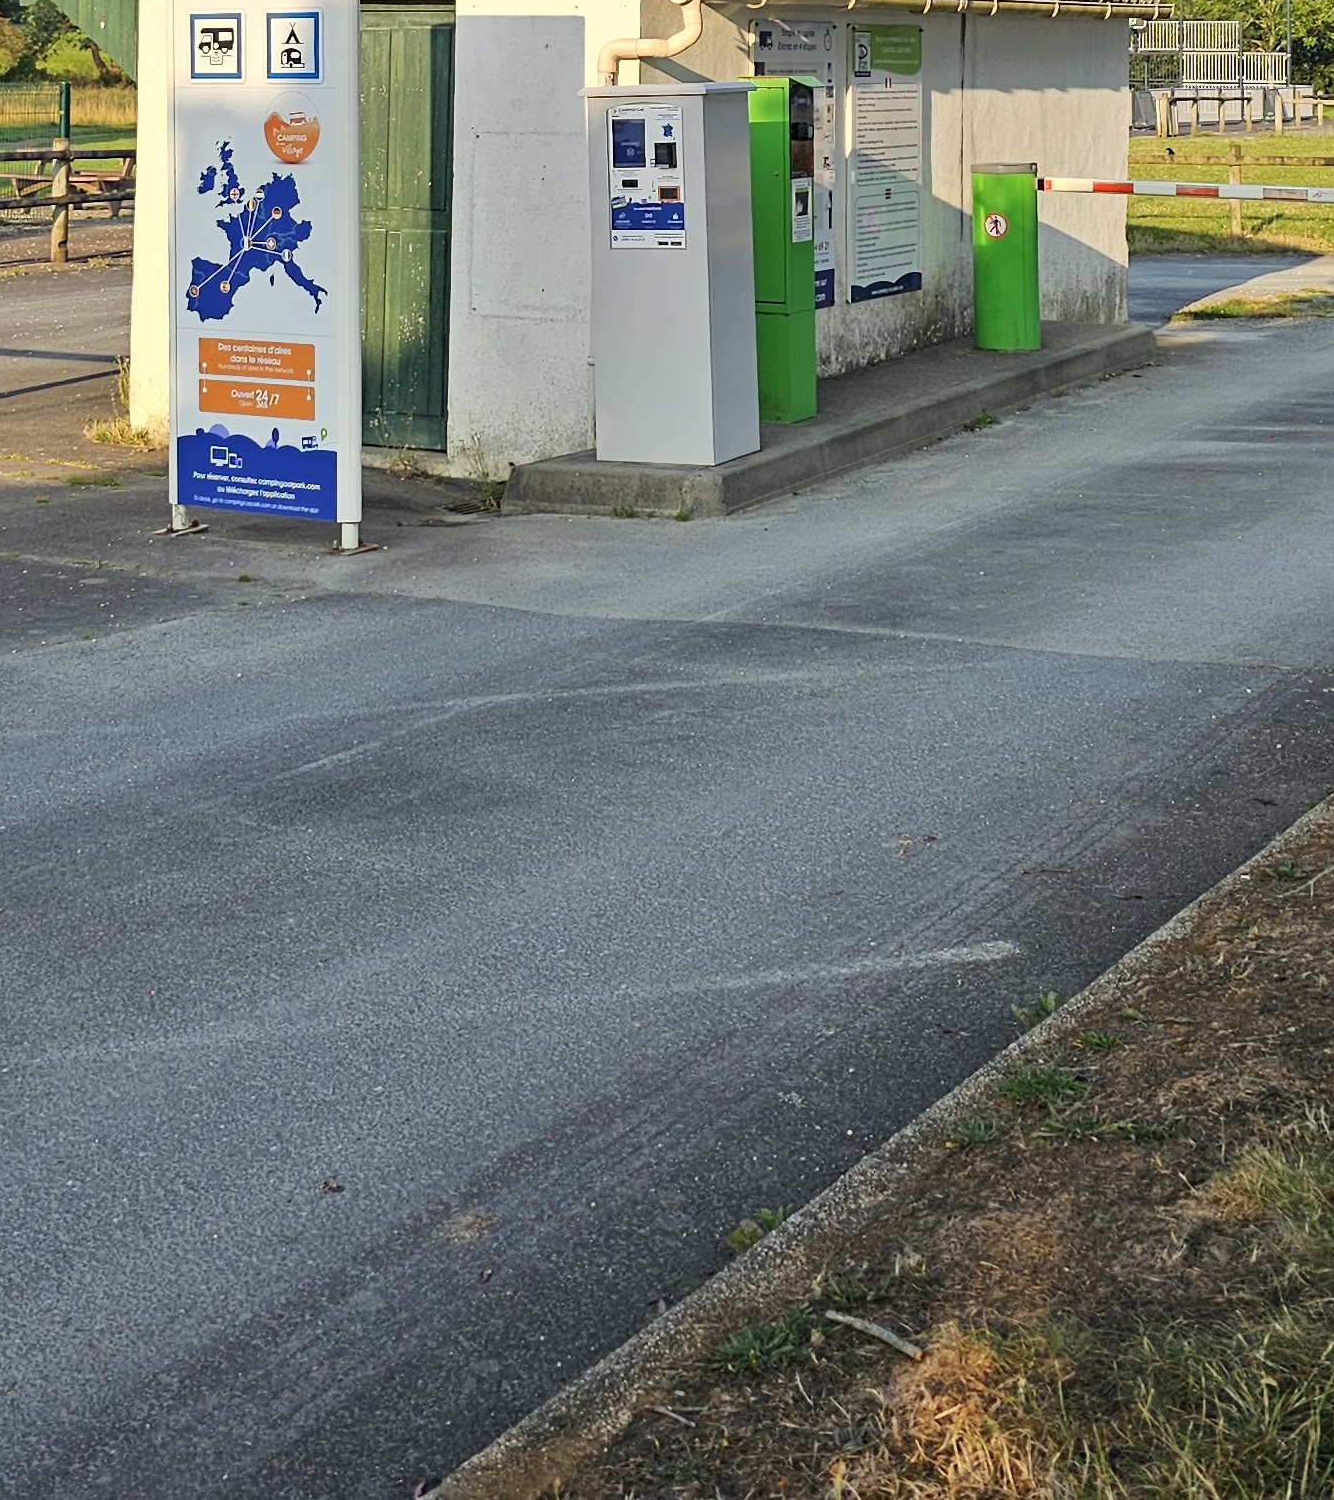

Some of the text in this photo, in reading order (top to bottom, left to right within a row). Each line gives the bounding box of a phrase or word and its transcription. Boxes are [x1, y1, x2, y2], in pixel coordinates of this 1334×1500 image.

[276, 133, 308, 142] CAMPING
[218, 342, 292, 355] Des centaines d'aires
[230, 355, 281, 366] dans le réseau
[231, 389, 280, 406] Ouvert 24 /7
